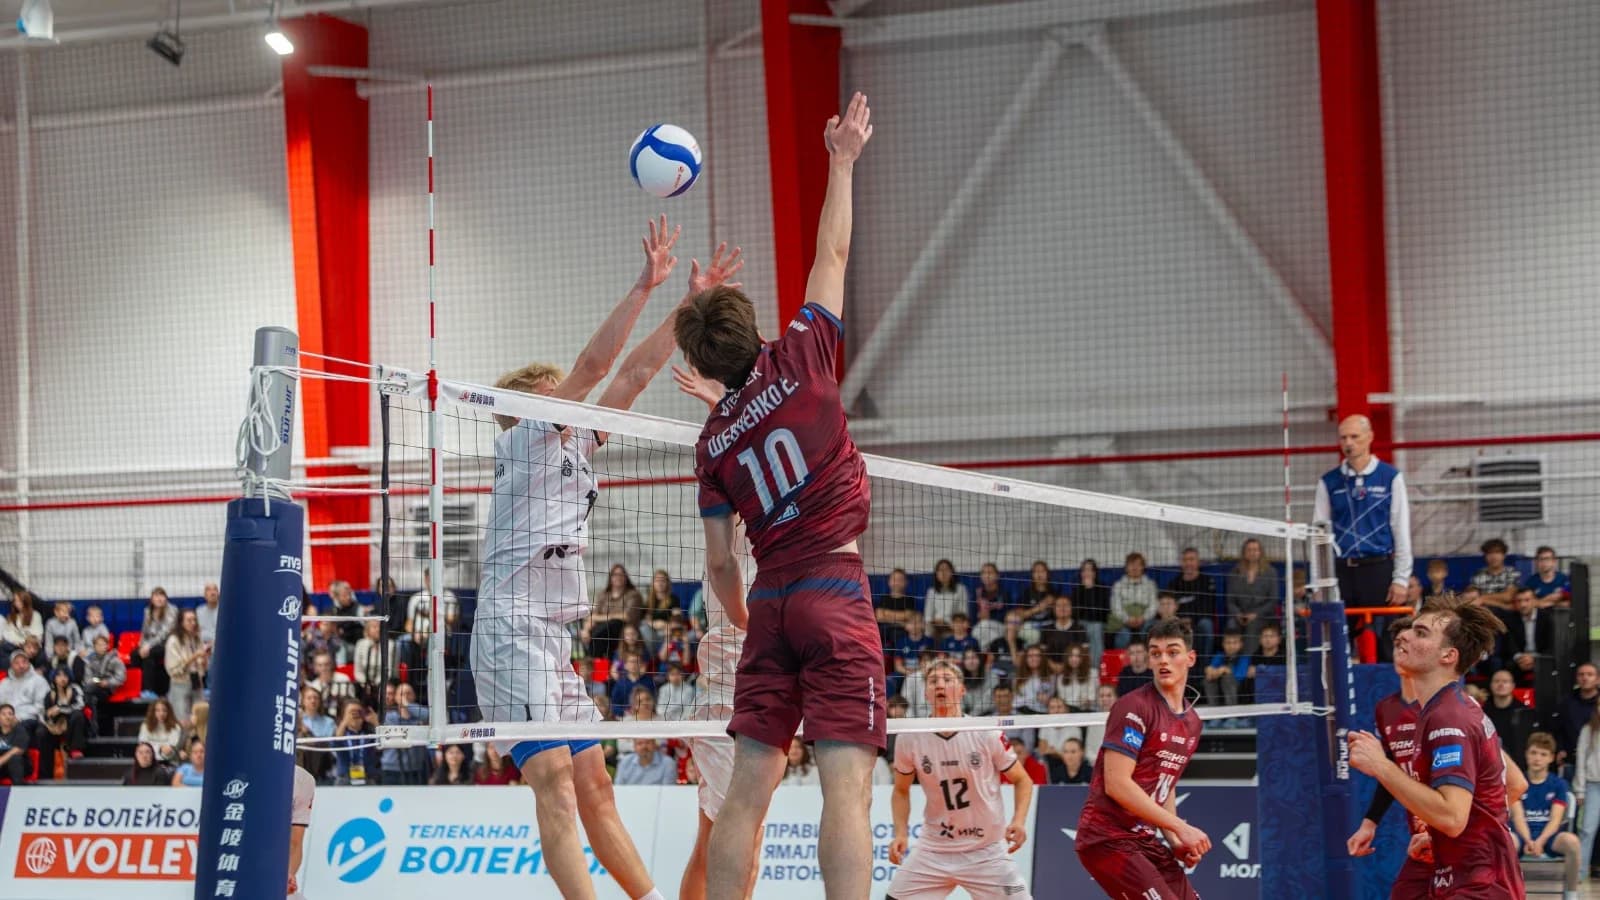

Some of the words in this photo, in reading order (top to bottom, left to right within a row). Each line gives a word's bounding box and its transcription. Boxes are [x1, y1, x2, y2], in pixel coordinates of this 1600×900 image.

[736, 428, 810, 516] 10
[273, 694, 284, 750] SPORTS
[24, 807, 77, 827] ВЕСЬ
[83, 803, 200, 828] ВОЛЕЙБО
[940, 777, 970, 811] 12
[214, 803, 245, 897] 金陵体育
[409, 824, 530, 839] ТЕЛЕКАНАЛ
